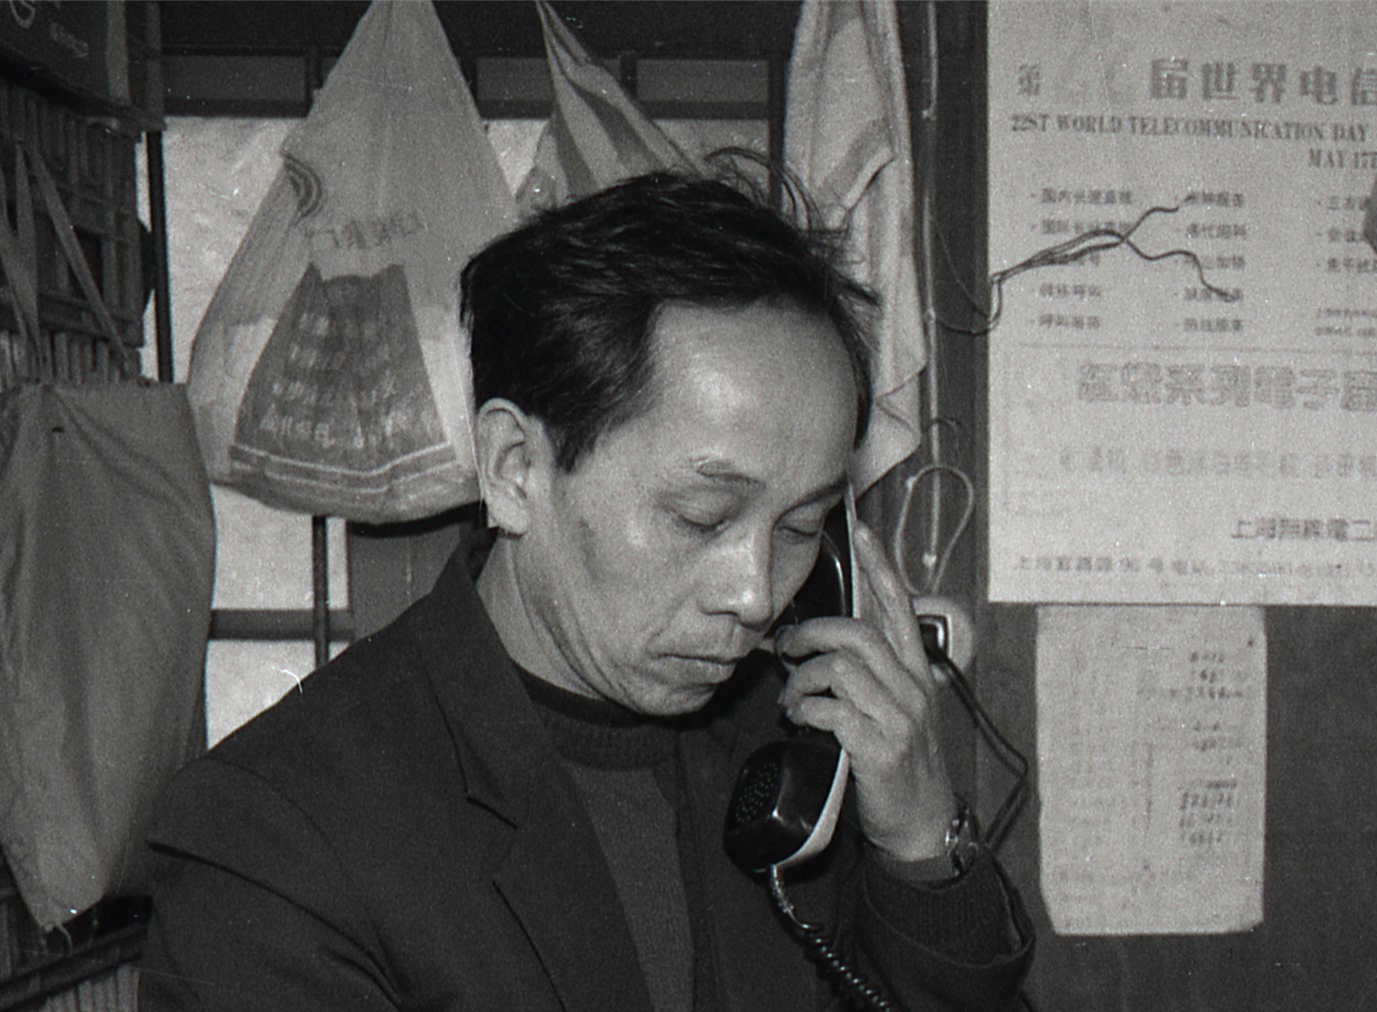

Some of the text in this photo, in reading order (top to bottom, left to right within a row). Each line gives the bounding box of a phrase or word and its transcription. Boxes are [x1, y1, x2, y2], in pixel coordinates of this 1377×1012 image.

[1056, 113, 1123, 134] WORLD
[1128, 115, 1325, 141] TELECOMMUNICATION
[1332, 122, 1368, 142] DAY
[1308, 148, 1346, 169] MAY
